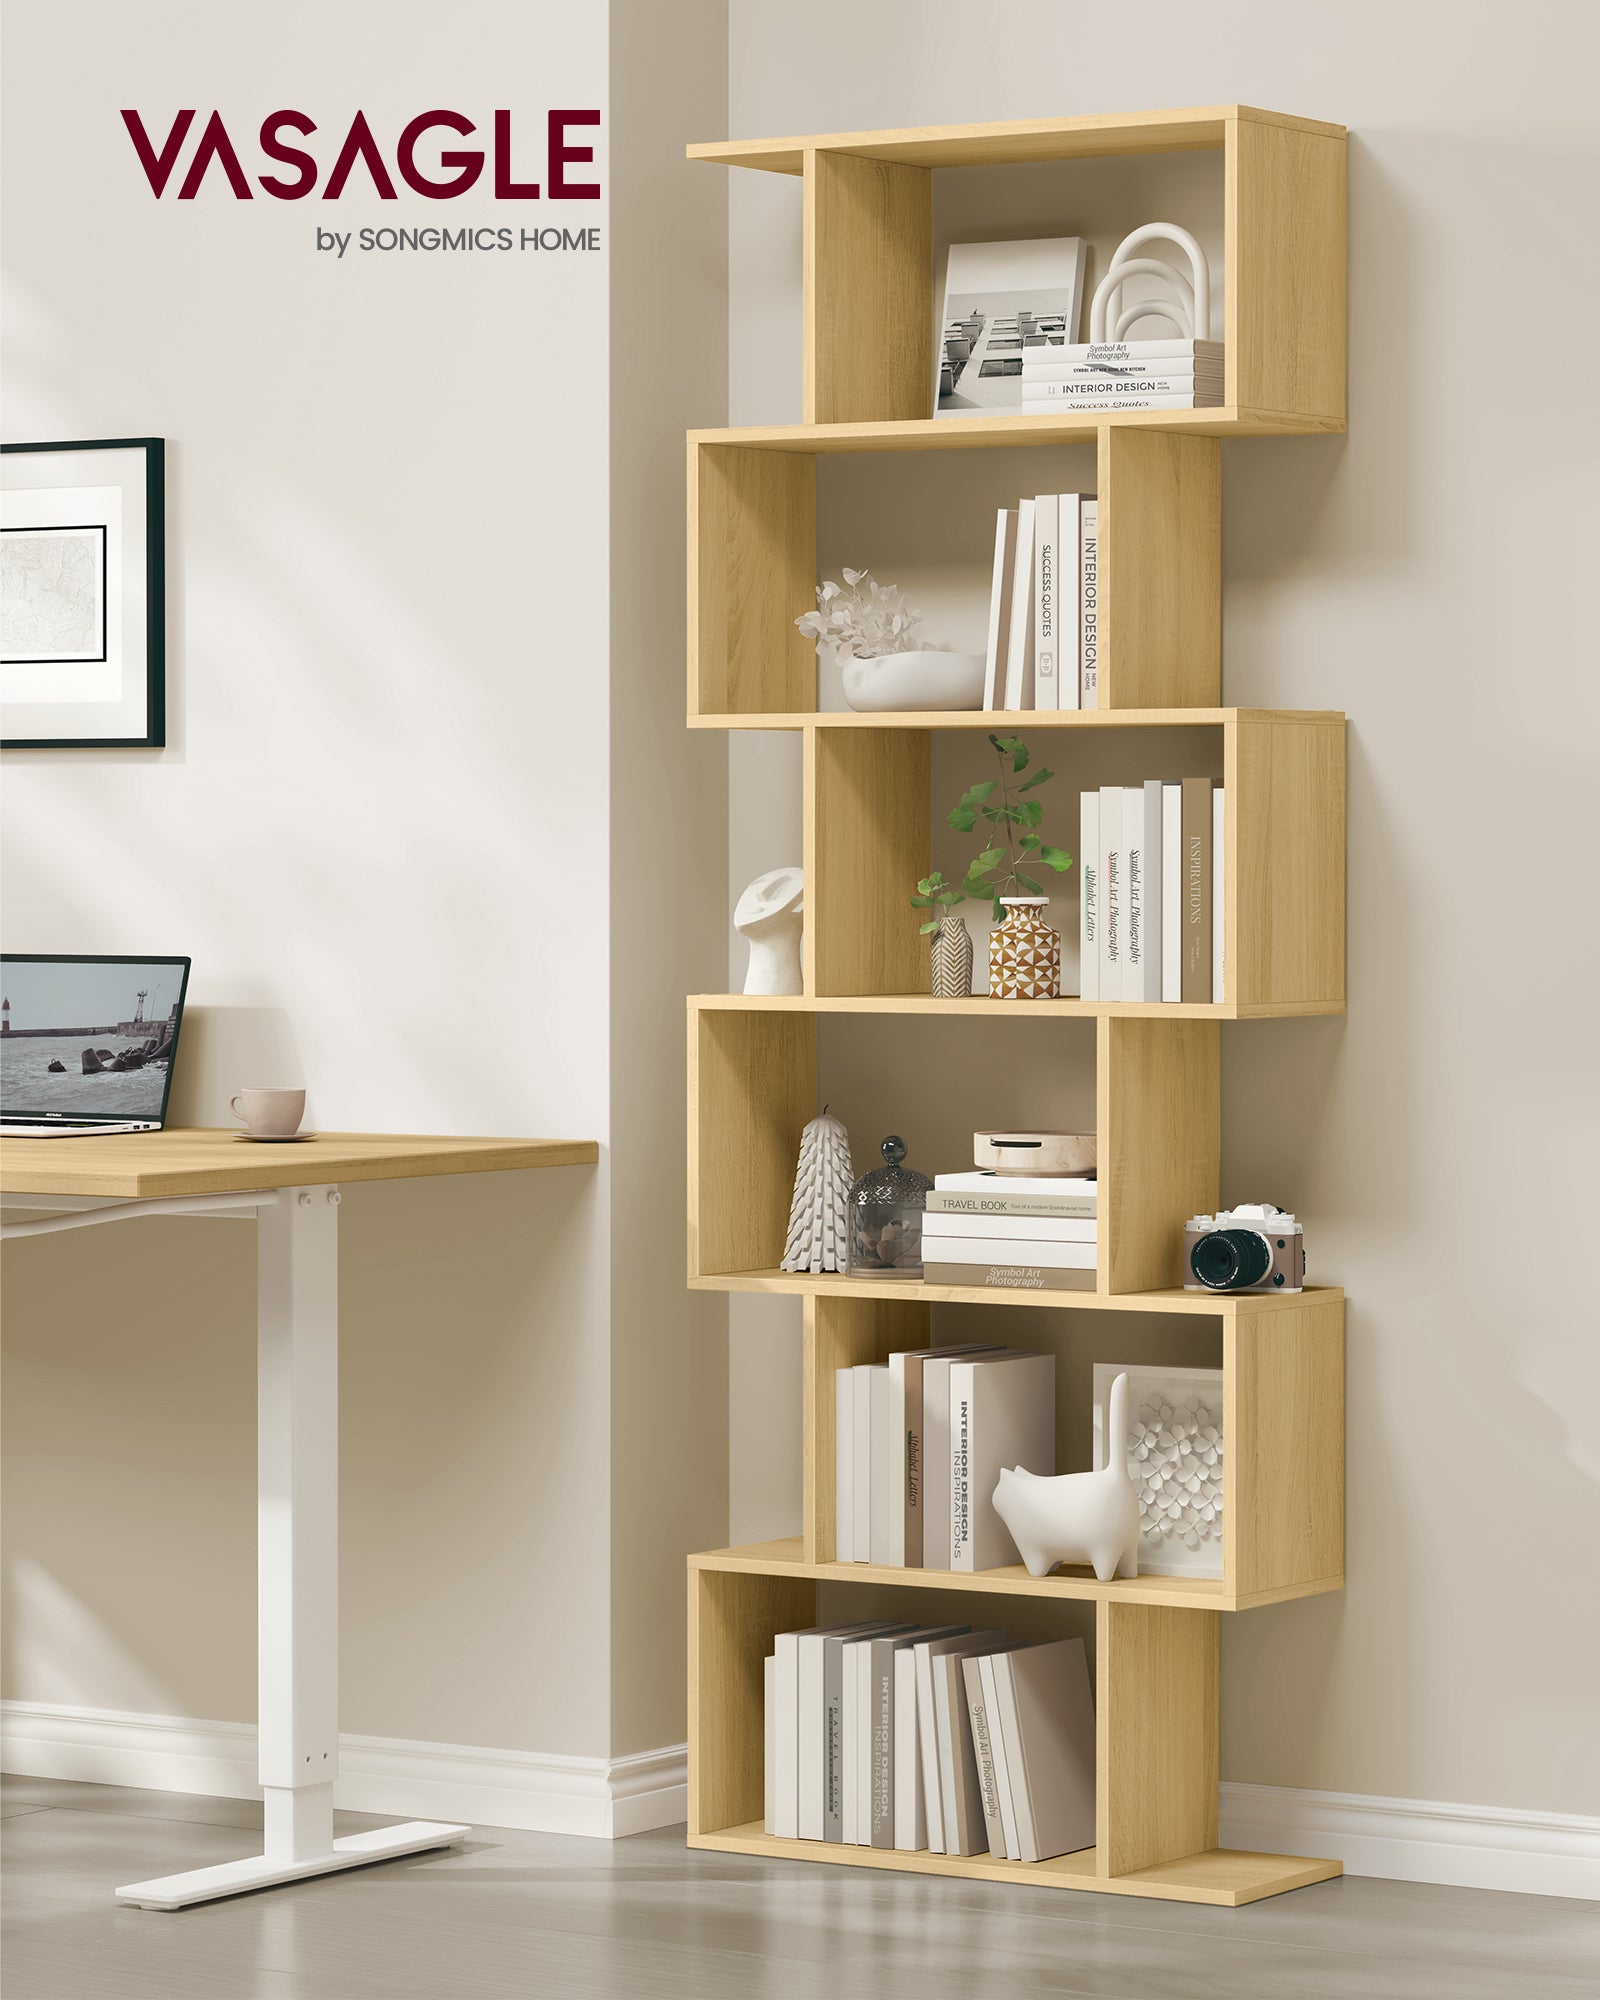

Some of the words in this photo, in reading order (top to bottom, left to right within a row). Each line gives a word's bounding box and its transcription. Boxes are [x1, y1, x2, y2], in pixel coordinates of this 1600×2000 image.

[1086, 351, 1130, 360] Photography
[1089, 344, 1115, 353] Symbol
[1116, 344, 1127, 352] Art
[1062, 383, 1113, 394] INTERIOR
[1116, 382, 1156, 392] DESIGN
[1067, 402, 1109, 410] Success
[1111, 401, 1150, 409] Quotes
[1042, 544, 1051, 592] SUCCESS
[1085, 538, 1096, 609] INTERIOR
[1041, 593, 1051, 637] QUOTES
[1085, 614, 1096, 669] DESIGN
[1109, 851, 1119, 885] Symbol
[1130, 849, 1140, 885] Symbol
[1190, 836, 1201, 924] INSPIRATIONS
[1086, 866, 1096, 907] Alphabet
[1110, 885, 1119, 901] Art
[1131, 885, 1140, 901] Art
[1088, 912, 1097, 942] Letters
[1108, 906, 1119, 963] Photography
[1130, 906, 1141, 964] Photography
[942, 1199, 978, 1210] TRAVEL
[981, 1201, 1007, 1211] BOOK
[985, 1275, 1044, 1287] Photography
[990, 1267, 1025, 1279] Symbol
[1026, 1268, 1041, 1277] Art
[909, 1432, 920, 1472] Alphabet
[909, 1475, 919, 1507] Letters
[953, 1451, 961, 1559] INSPIRATIONS
[973, 1705, 987, 1742] Symbol
[978, 1741, 988, 1760] Art
[873, 1726, 881, 1835] INSPIRATIONS
[982, 1760, 998, 1819] Photography
